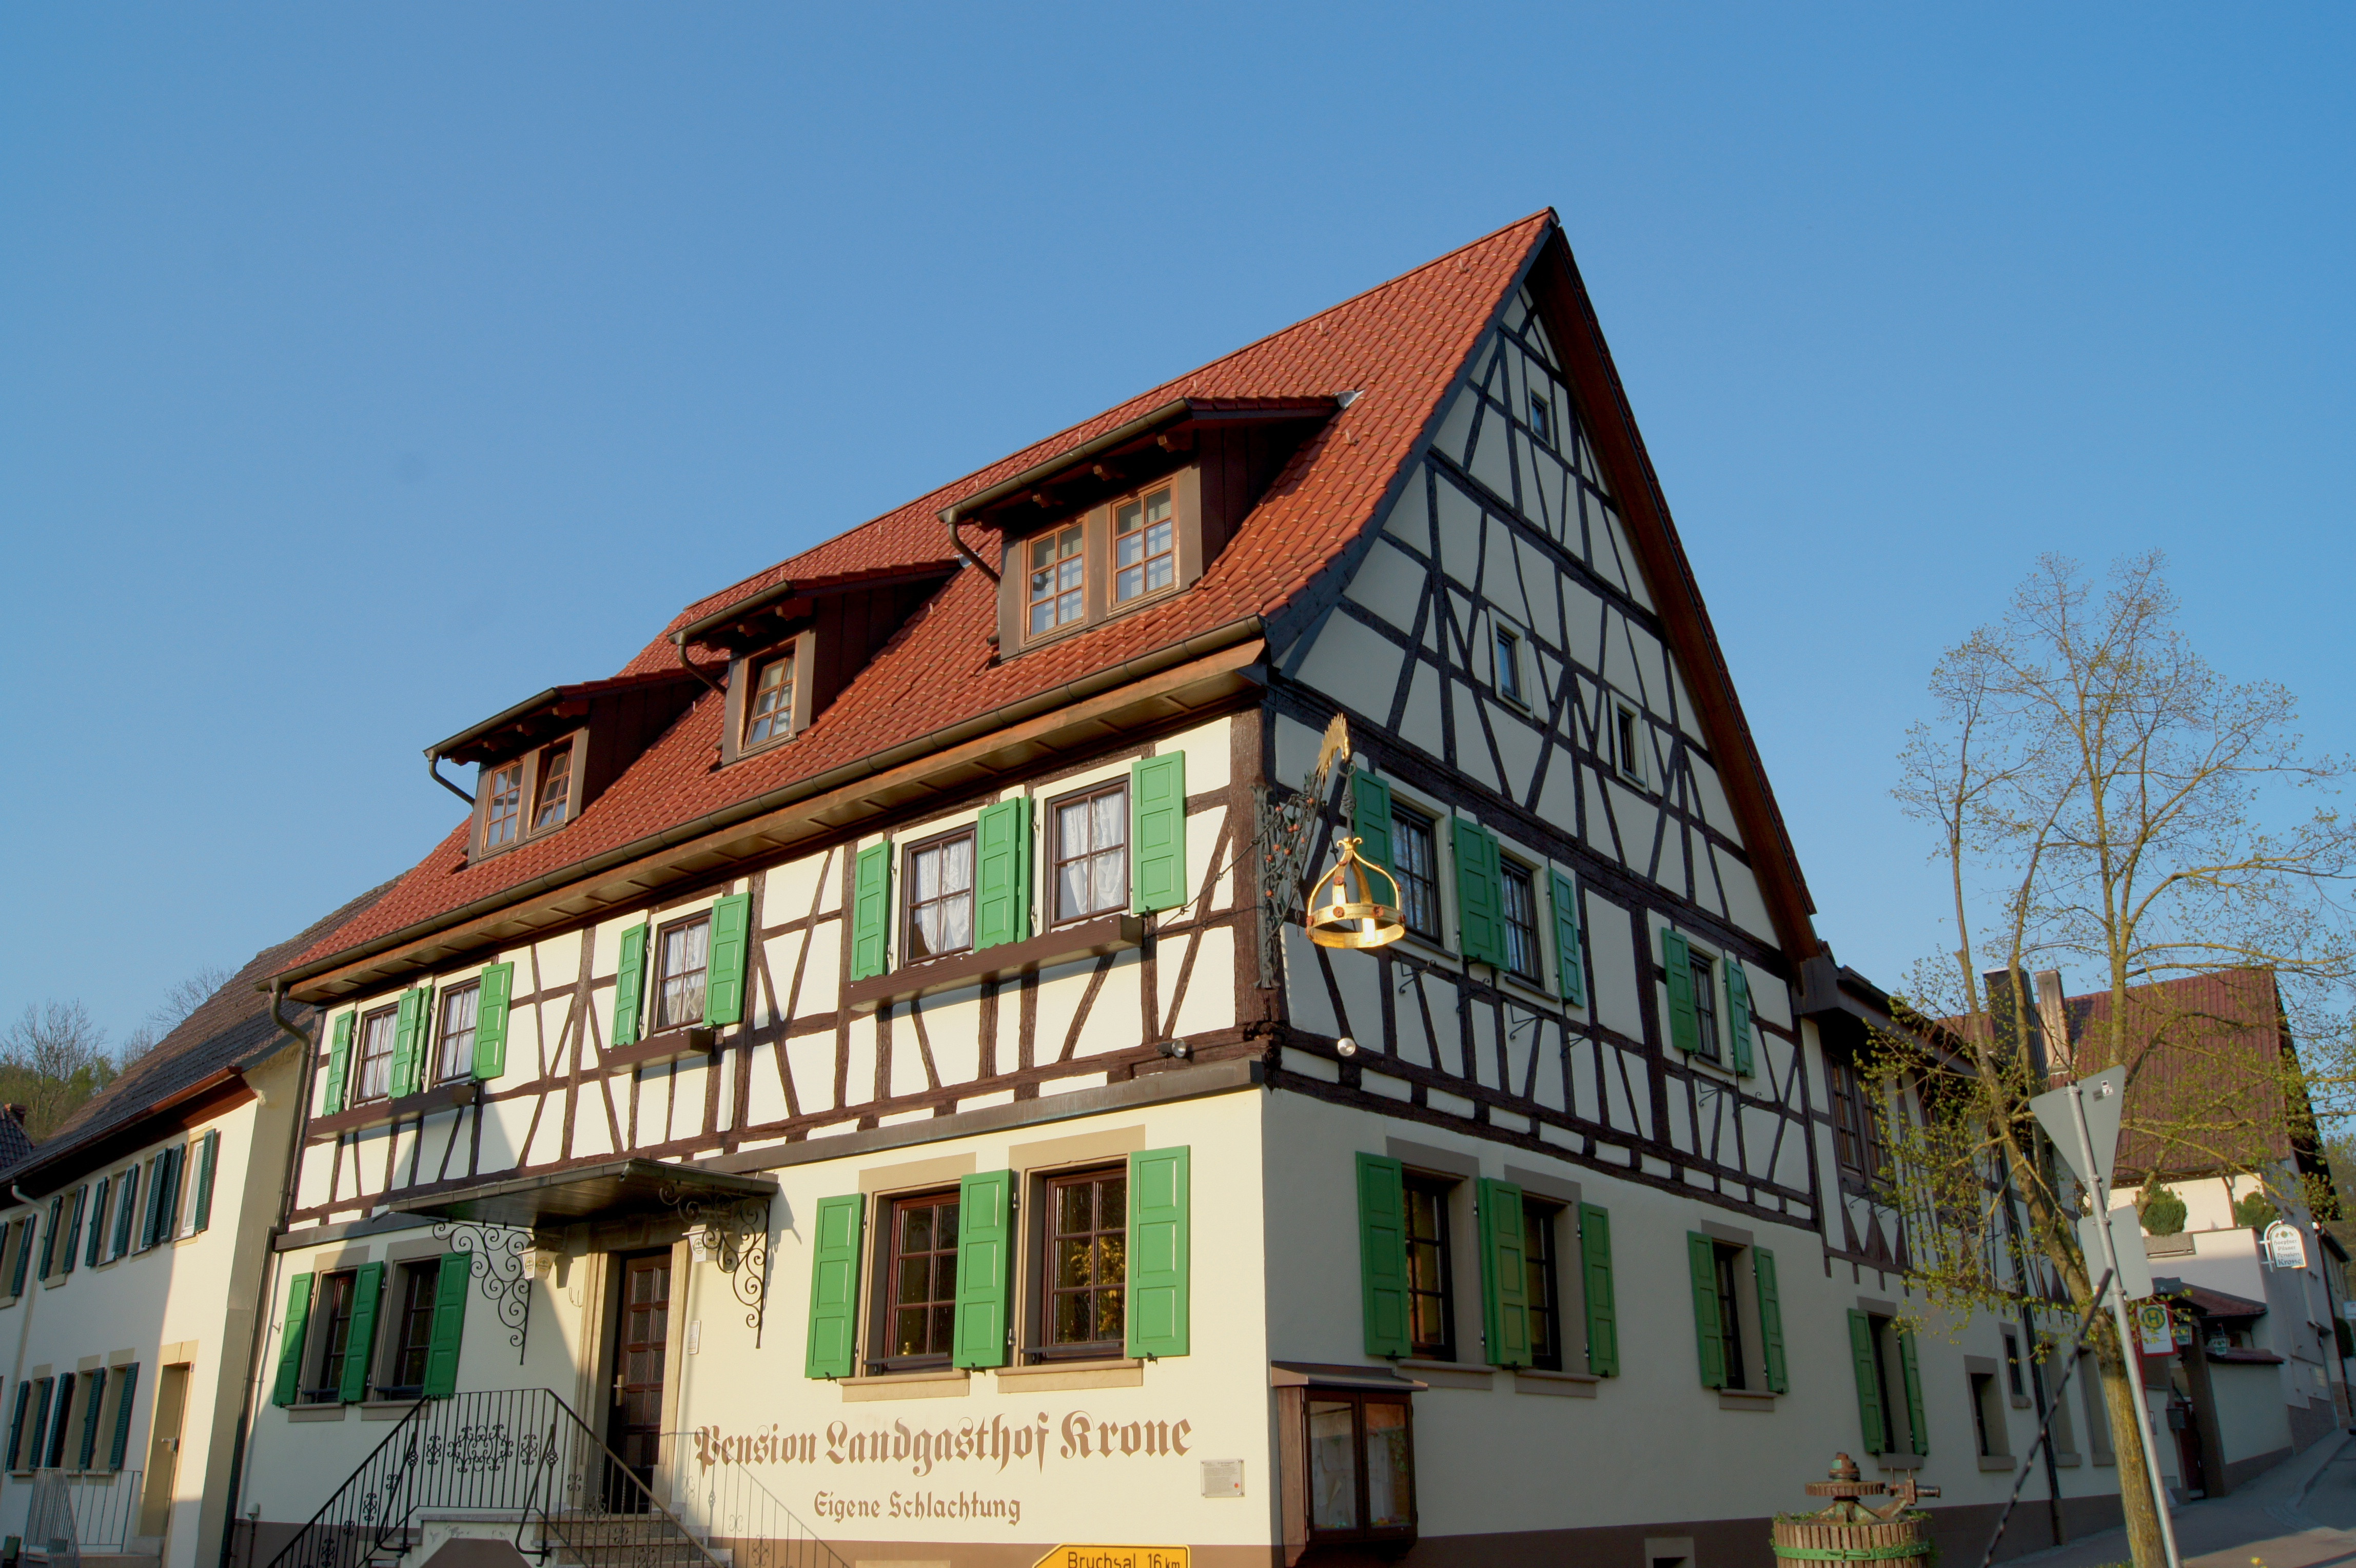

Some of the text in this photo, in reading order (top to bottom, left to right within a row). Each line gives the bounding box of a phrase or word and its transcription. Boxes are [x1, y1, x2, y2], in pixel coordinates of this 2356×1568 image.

[695, 1410, 1193, 1478] Pension Landgasthof Krone
[814, 1490, 1020, 1527] Eigene Schlachtung
[1068, 1551, 1180, 1568] Bruchsal 16 km
